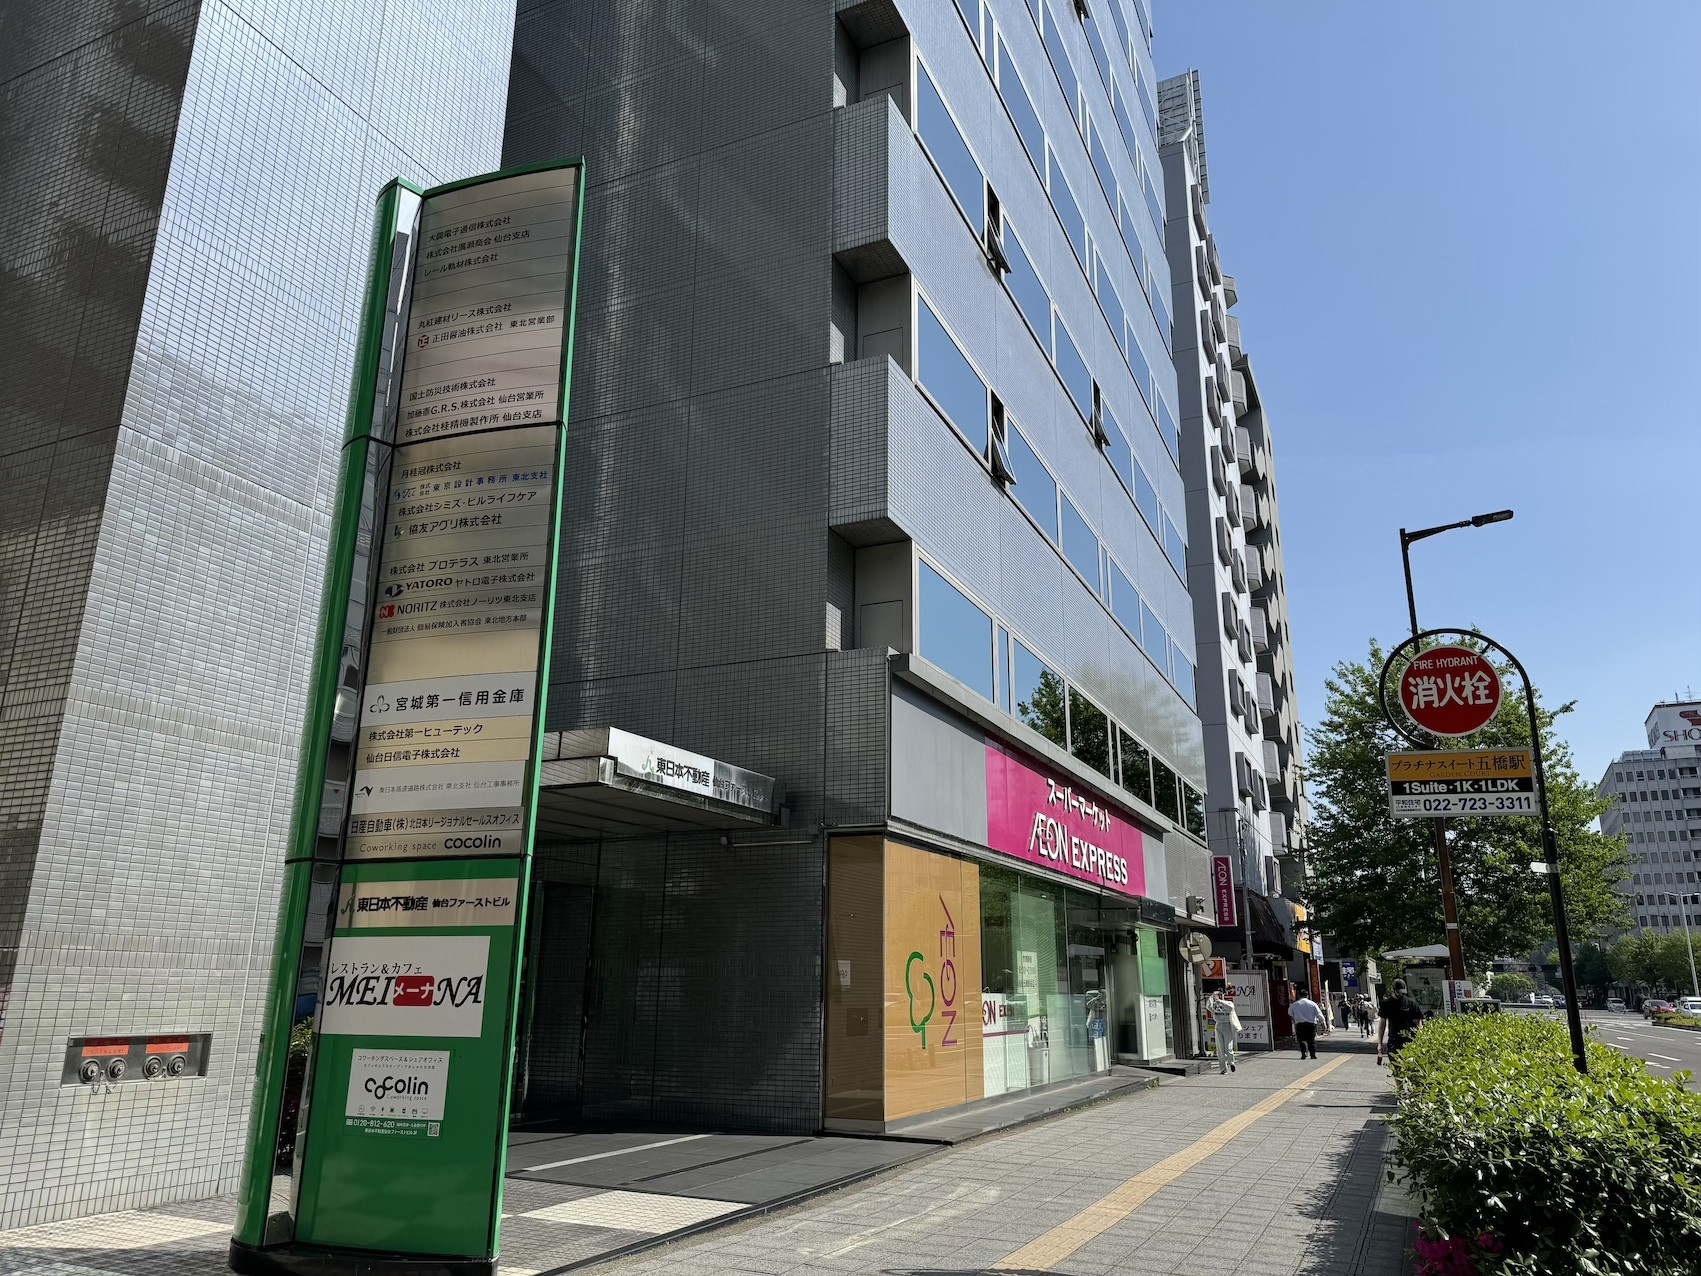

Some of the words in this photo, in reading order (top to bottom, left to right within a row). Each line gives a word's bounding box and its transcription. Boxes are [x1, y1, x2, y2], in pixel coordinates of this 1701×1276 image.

[494, 229, 531, 245] 仙台支店
[417, 303, 513, 330] 丸紅建材リース株式会社
[510, 315, 555, 329] 東北営業部
[409, 378, 496, 402] 国土防災技術株式会社
[498, 390, 545, 405] 仙台営業所
[405, 413, 500, 438] 株式会社桂精機製作所
[502, 409, 543, 422] 仙台支店
[401, 461, 462, 480] 月桂冠株式会社
[512, 471, 548, 482] 東北支社
[409, 514, 502, 535] 協友アグリ株式会社
[389, 564, 425, 576] 株式会社
[428, 556, 479, 571] プロテラス
[482, 552, 529, 564] 東北営業所
[405, 577, 453, 590] YATORO
[455, 572, 535, 588] ヤトロ電子株式会社
[397, 601, 437, 616] NORITZ
[484, 614, 527, 626] 東北地方本部
[1413, 659, 1434, 671] FIRE
[1436, 655, 1479, 669] HYDRANT
[1407, 670, 1494, 710] 消火栓
[396, 688, 525, 712] 宮城第一信用金庫
[368, 724, 483, 742] 株式会社第一ヒューテック
[366, 748, 461, 764] 仙台日信電子株式会社
[1391, 754, 1527, 773] プラチナスイート五橋駅
[656, 757, 710, 788] 東日本不動産
[446, 781, 471, 791] 東北支社
[1047, 778, 1111, 833] スーパーマーケット
[1423, 797, 1532, 812] 022-723-3311
[359, 842, 408, 853] Coworking
[411, 842, 437, 852] space
[444, 834, 502, 849] cocolin
[1070, 835, 1129, 886] EXPRESS
[356, 896, 428, 912] 東日本不動産
[432, 897, 510, 909] 仙台ファーストビル
[1221, 889, 1230, 922] EXPRESS
[326, 975, 396, 1007] MEI
[394, 982, 435, 999] メーナ
[433, 974, 484, 1008] NA
[364, 1076, 429, 1100] cocolin
[353, 1119, 395, 1128] 0120-812-620
